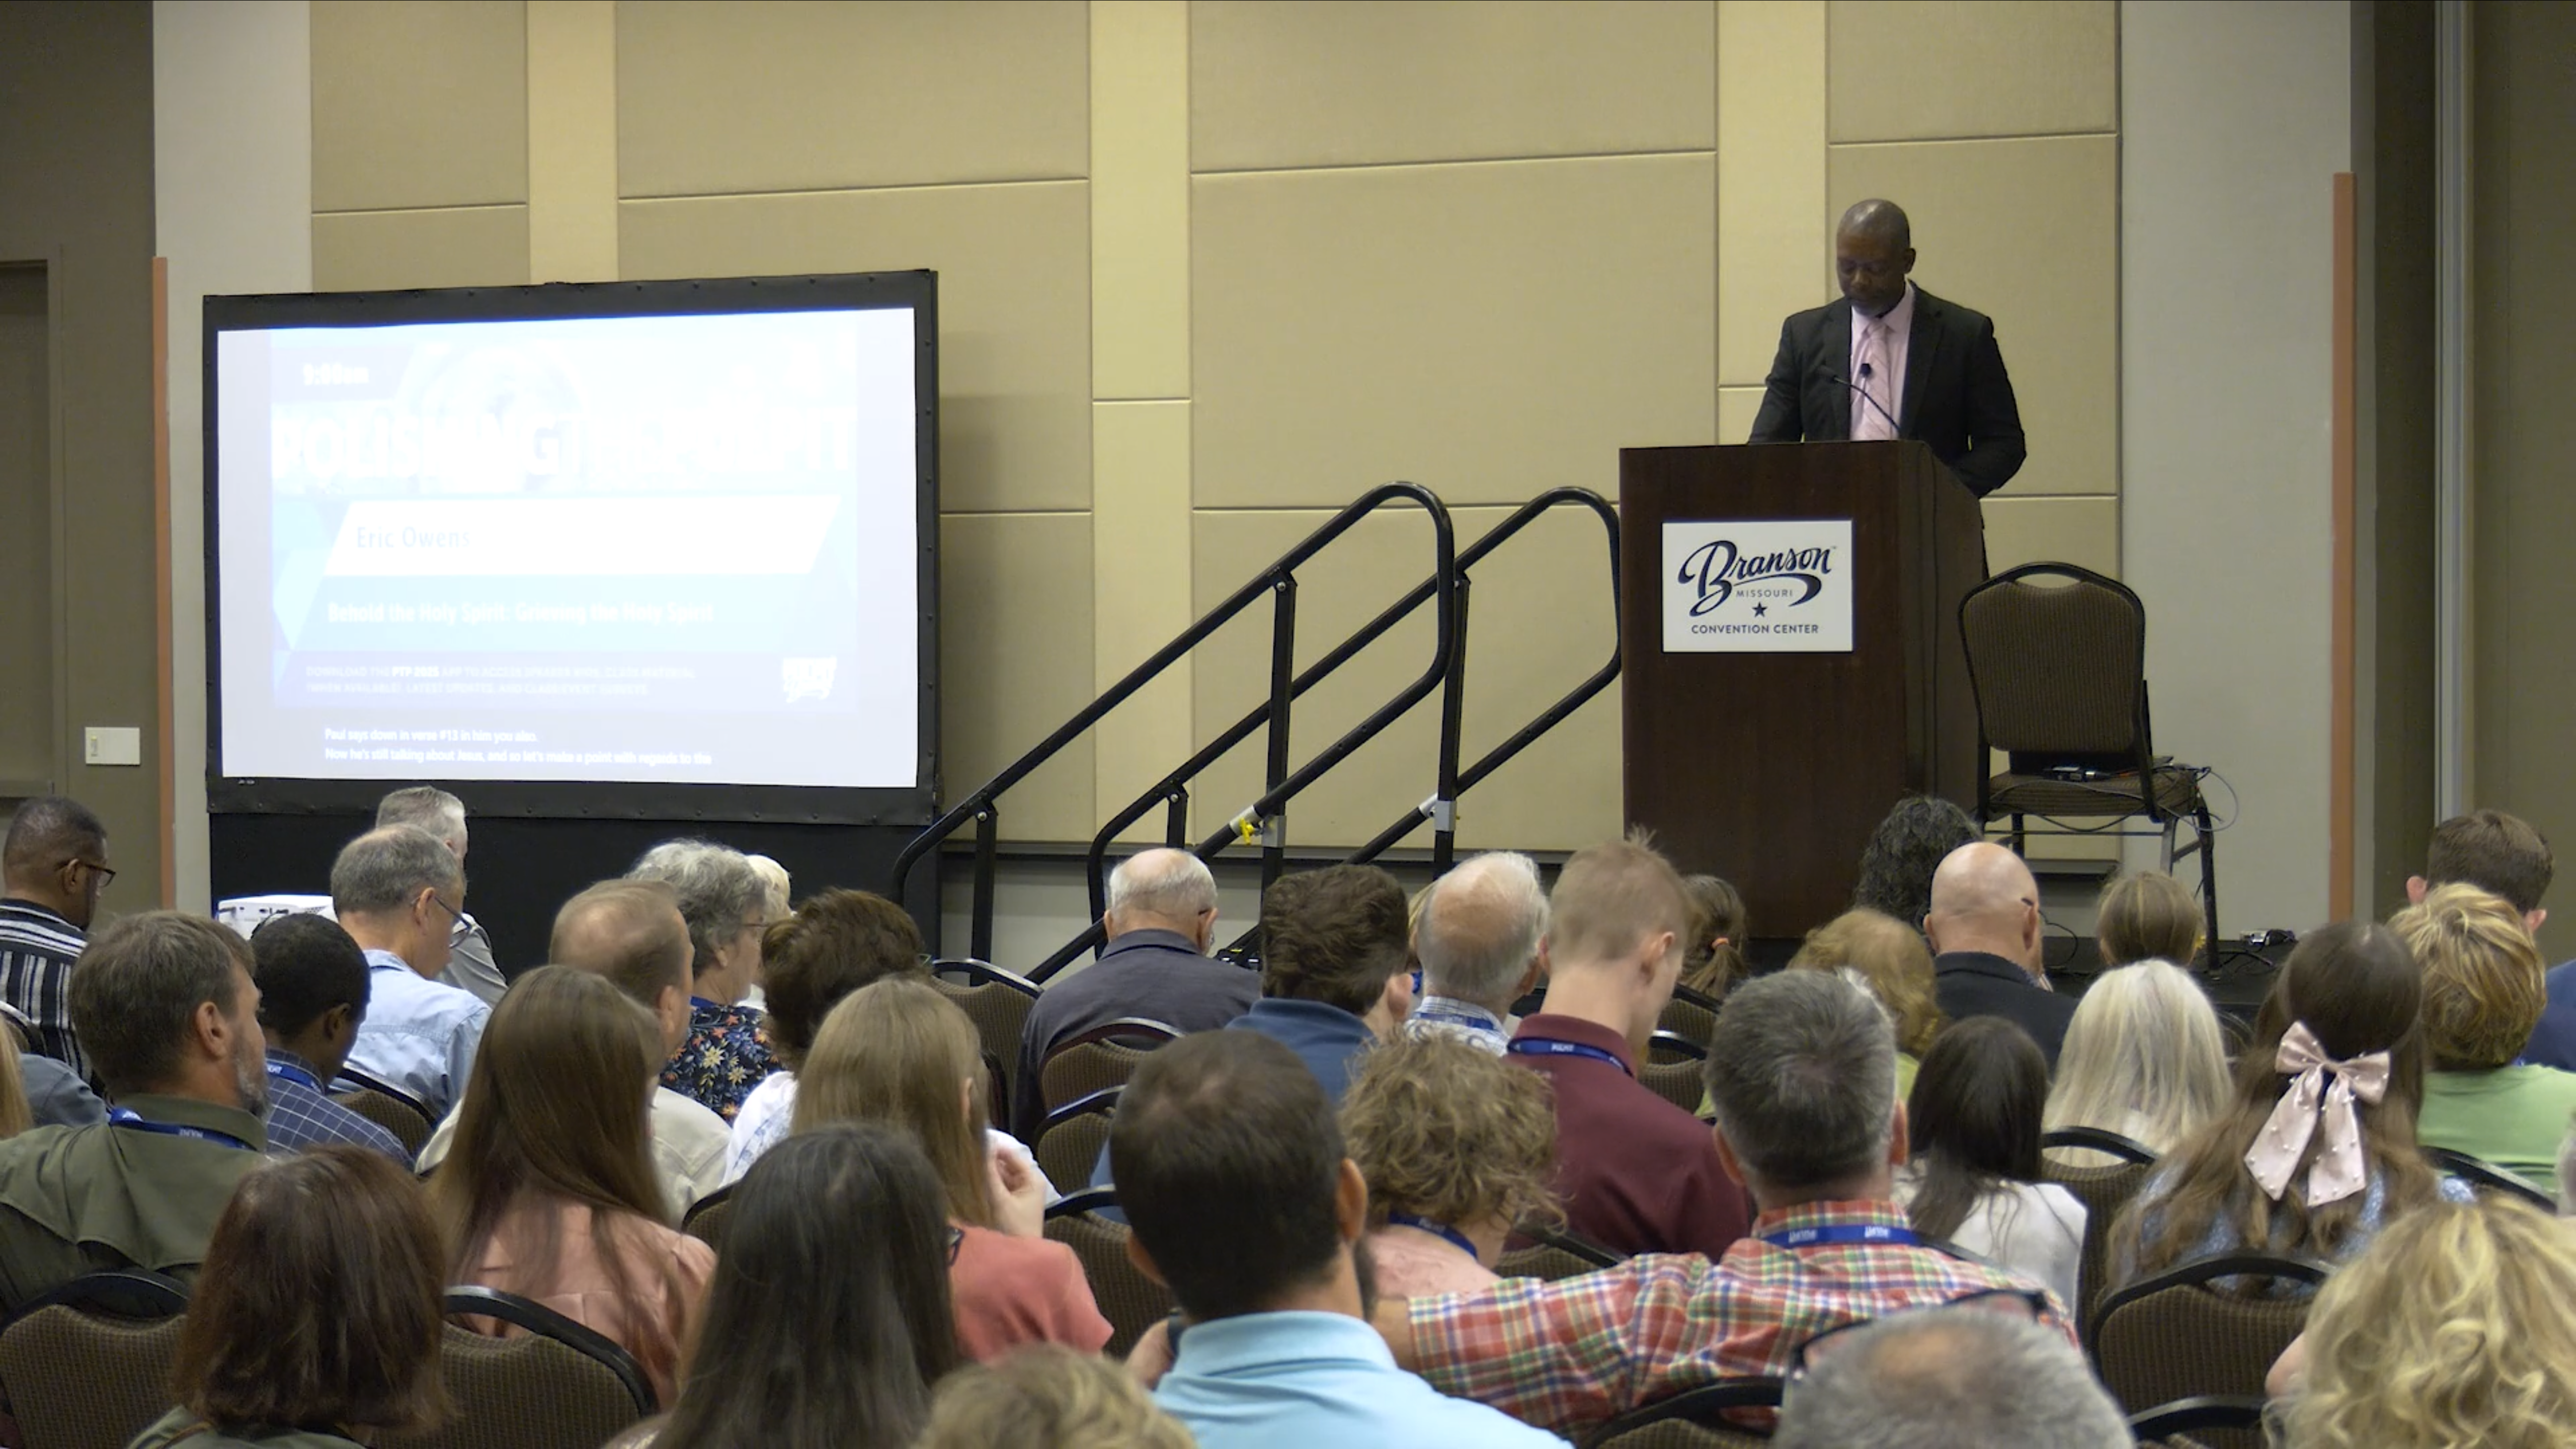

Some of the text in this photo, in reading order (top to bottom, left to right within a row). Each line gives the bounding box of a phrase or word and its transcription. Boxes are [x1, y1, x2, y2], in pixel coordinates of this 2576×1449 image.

[304, 363, 369, 386] 9:00am
[357, 526, 471, 548] Eric Owens
[1678, 540, 1832, 617] Branson
[1736, 589, 1794, 598] MISSOURI
[328, 601, 714, 625] Behold the Holy Spirit: Grieving the Holy Spirit
[1691, 624, 1819, 634] CONVENTION CENTER
[391, 666, 413, 677] PTP
[413, 666, 440, 677] 2025
[325, 729, 346, 740] Paul
[348, 731, 368, 743] says
[370, 730, 397, 741] down
[399, 730, 409, 741] in
[412, 732, 437, 741] verse
[440, 730, 459, 741] #13
[460, 730, 470, 741] in
[472, 730, 492, 741] him
[494, 732, 513, 744] you
[325, 748, 712, 767] Now he's still talking about Jesus, and so let's make a point with regards to the
